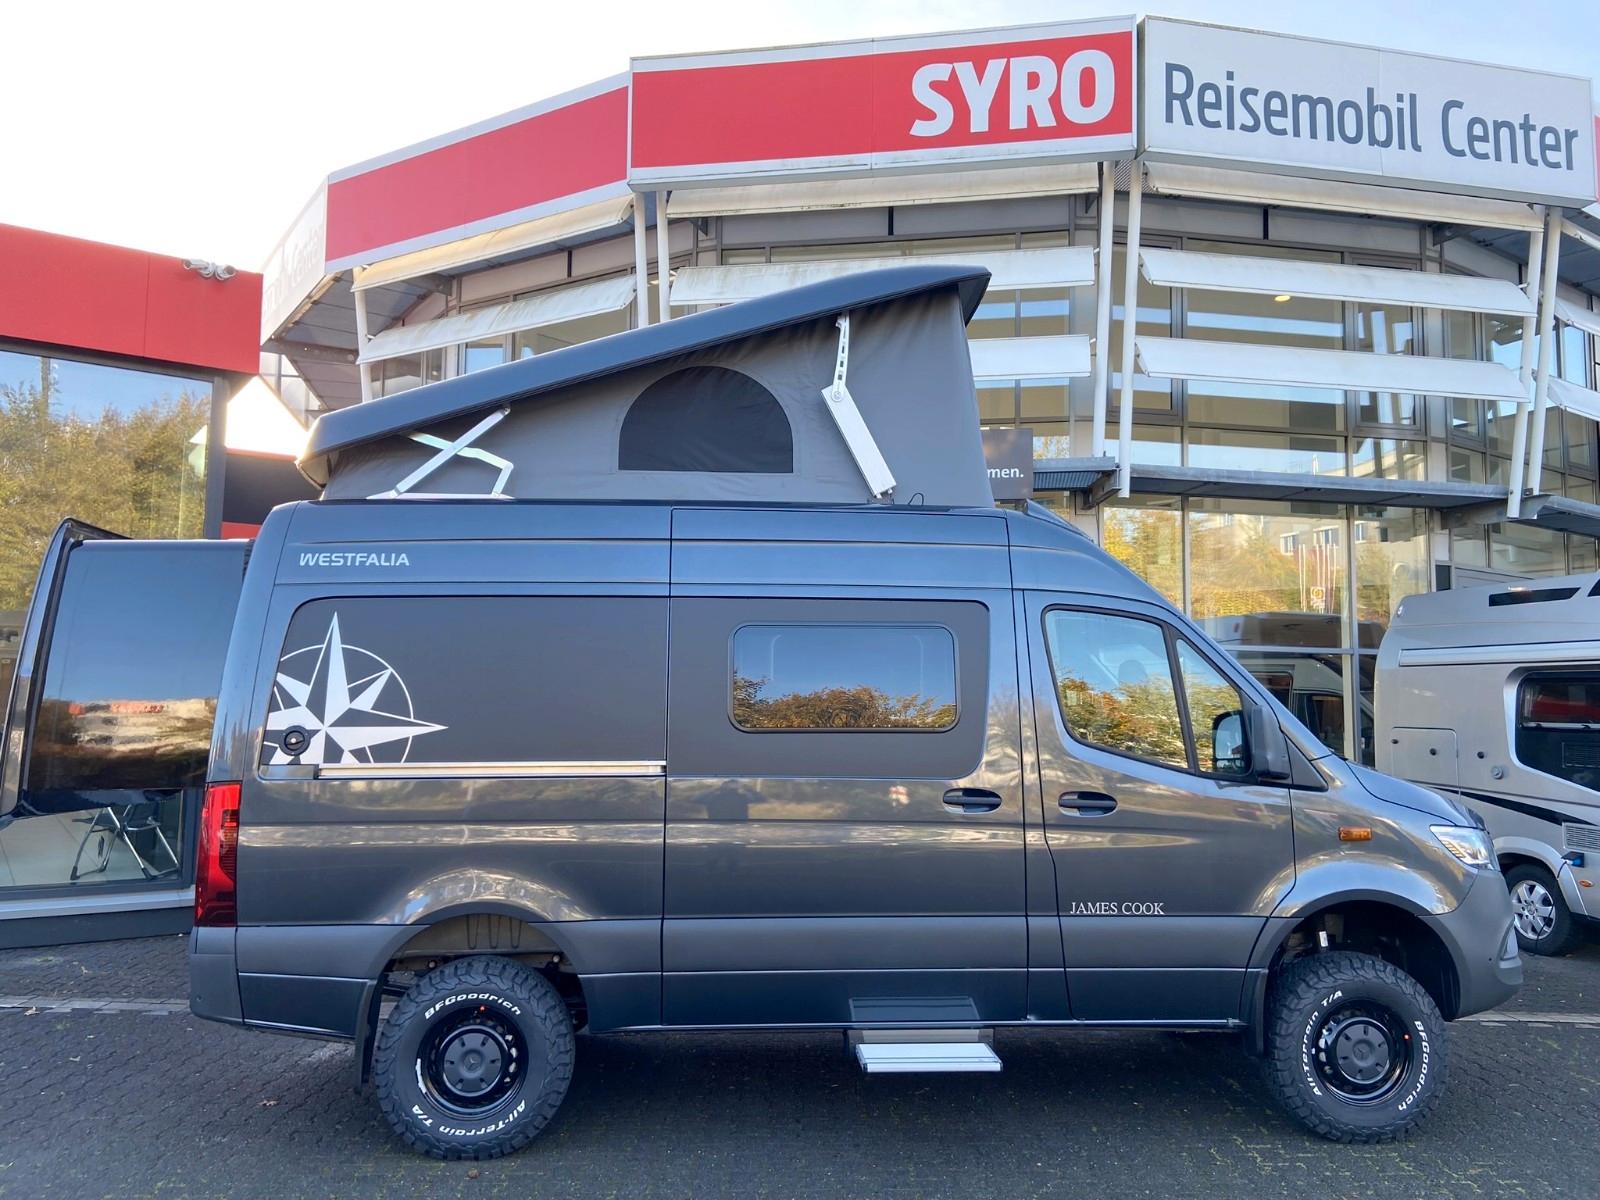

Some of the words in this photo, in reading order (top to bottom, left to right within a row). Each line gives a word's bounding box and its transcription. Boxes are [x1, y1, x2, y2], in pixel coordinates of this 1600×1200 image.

[910, 49, 1115, 137] SYRO
[1165, 62, 1422, 153] Reisemobil
[1442, 99, 1579, 171] Center
[299, 552, 410, 566] WESTFALIA
[1070, 902, 1118, 915] JAMES
[1122, 902, 1165, 915] COOK
[424, 992, 522, 1020] BFGoodrich
[1302, 1011, 1323, 1096] All-Terrain
[1321, 990, 1343, 1007] T/A
[1398, 1020, 1430, 1111] BFGoodrich
[411, 1104, 434, 1127] T/A
[439, 1099, 526, 1136] All-Terrain
